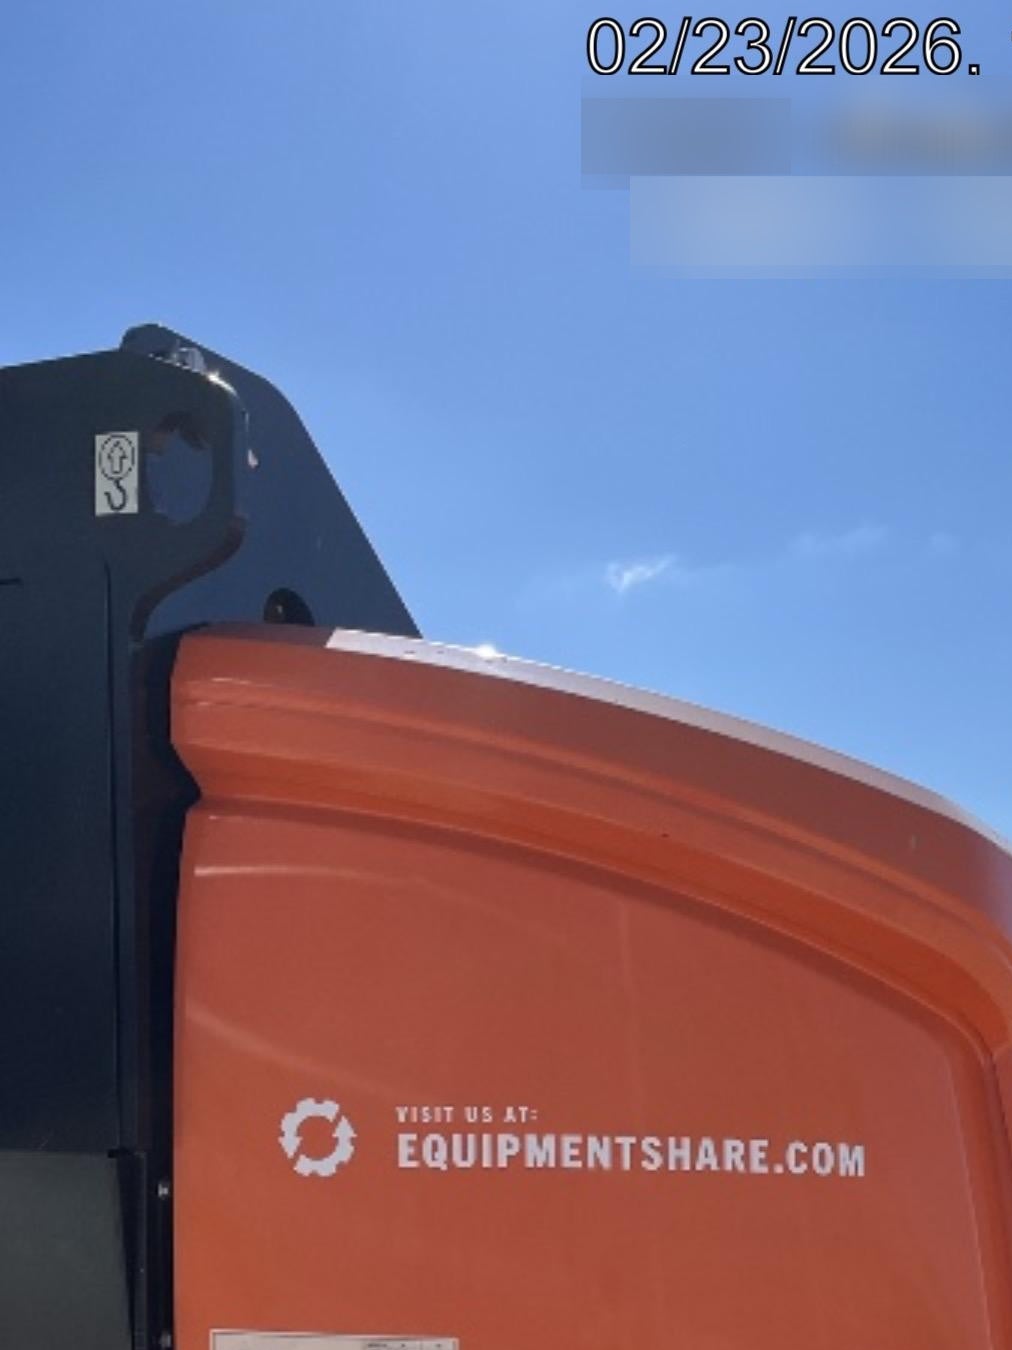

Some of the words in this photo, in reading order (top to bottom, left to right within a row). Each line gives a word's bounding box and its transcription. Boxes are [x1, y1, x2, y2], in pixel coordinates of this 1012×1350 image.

[395, 1106, 454, 1123] VISIT
[464, 1106, 493, 1123] US
[503, 1106, 539, 1123] AT:
[398, 1132, 867, 1179] EQUIPMENTSHARE.COM
